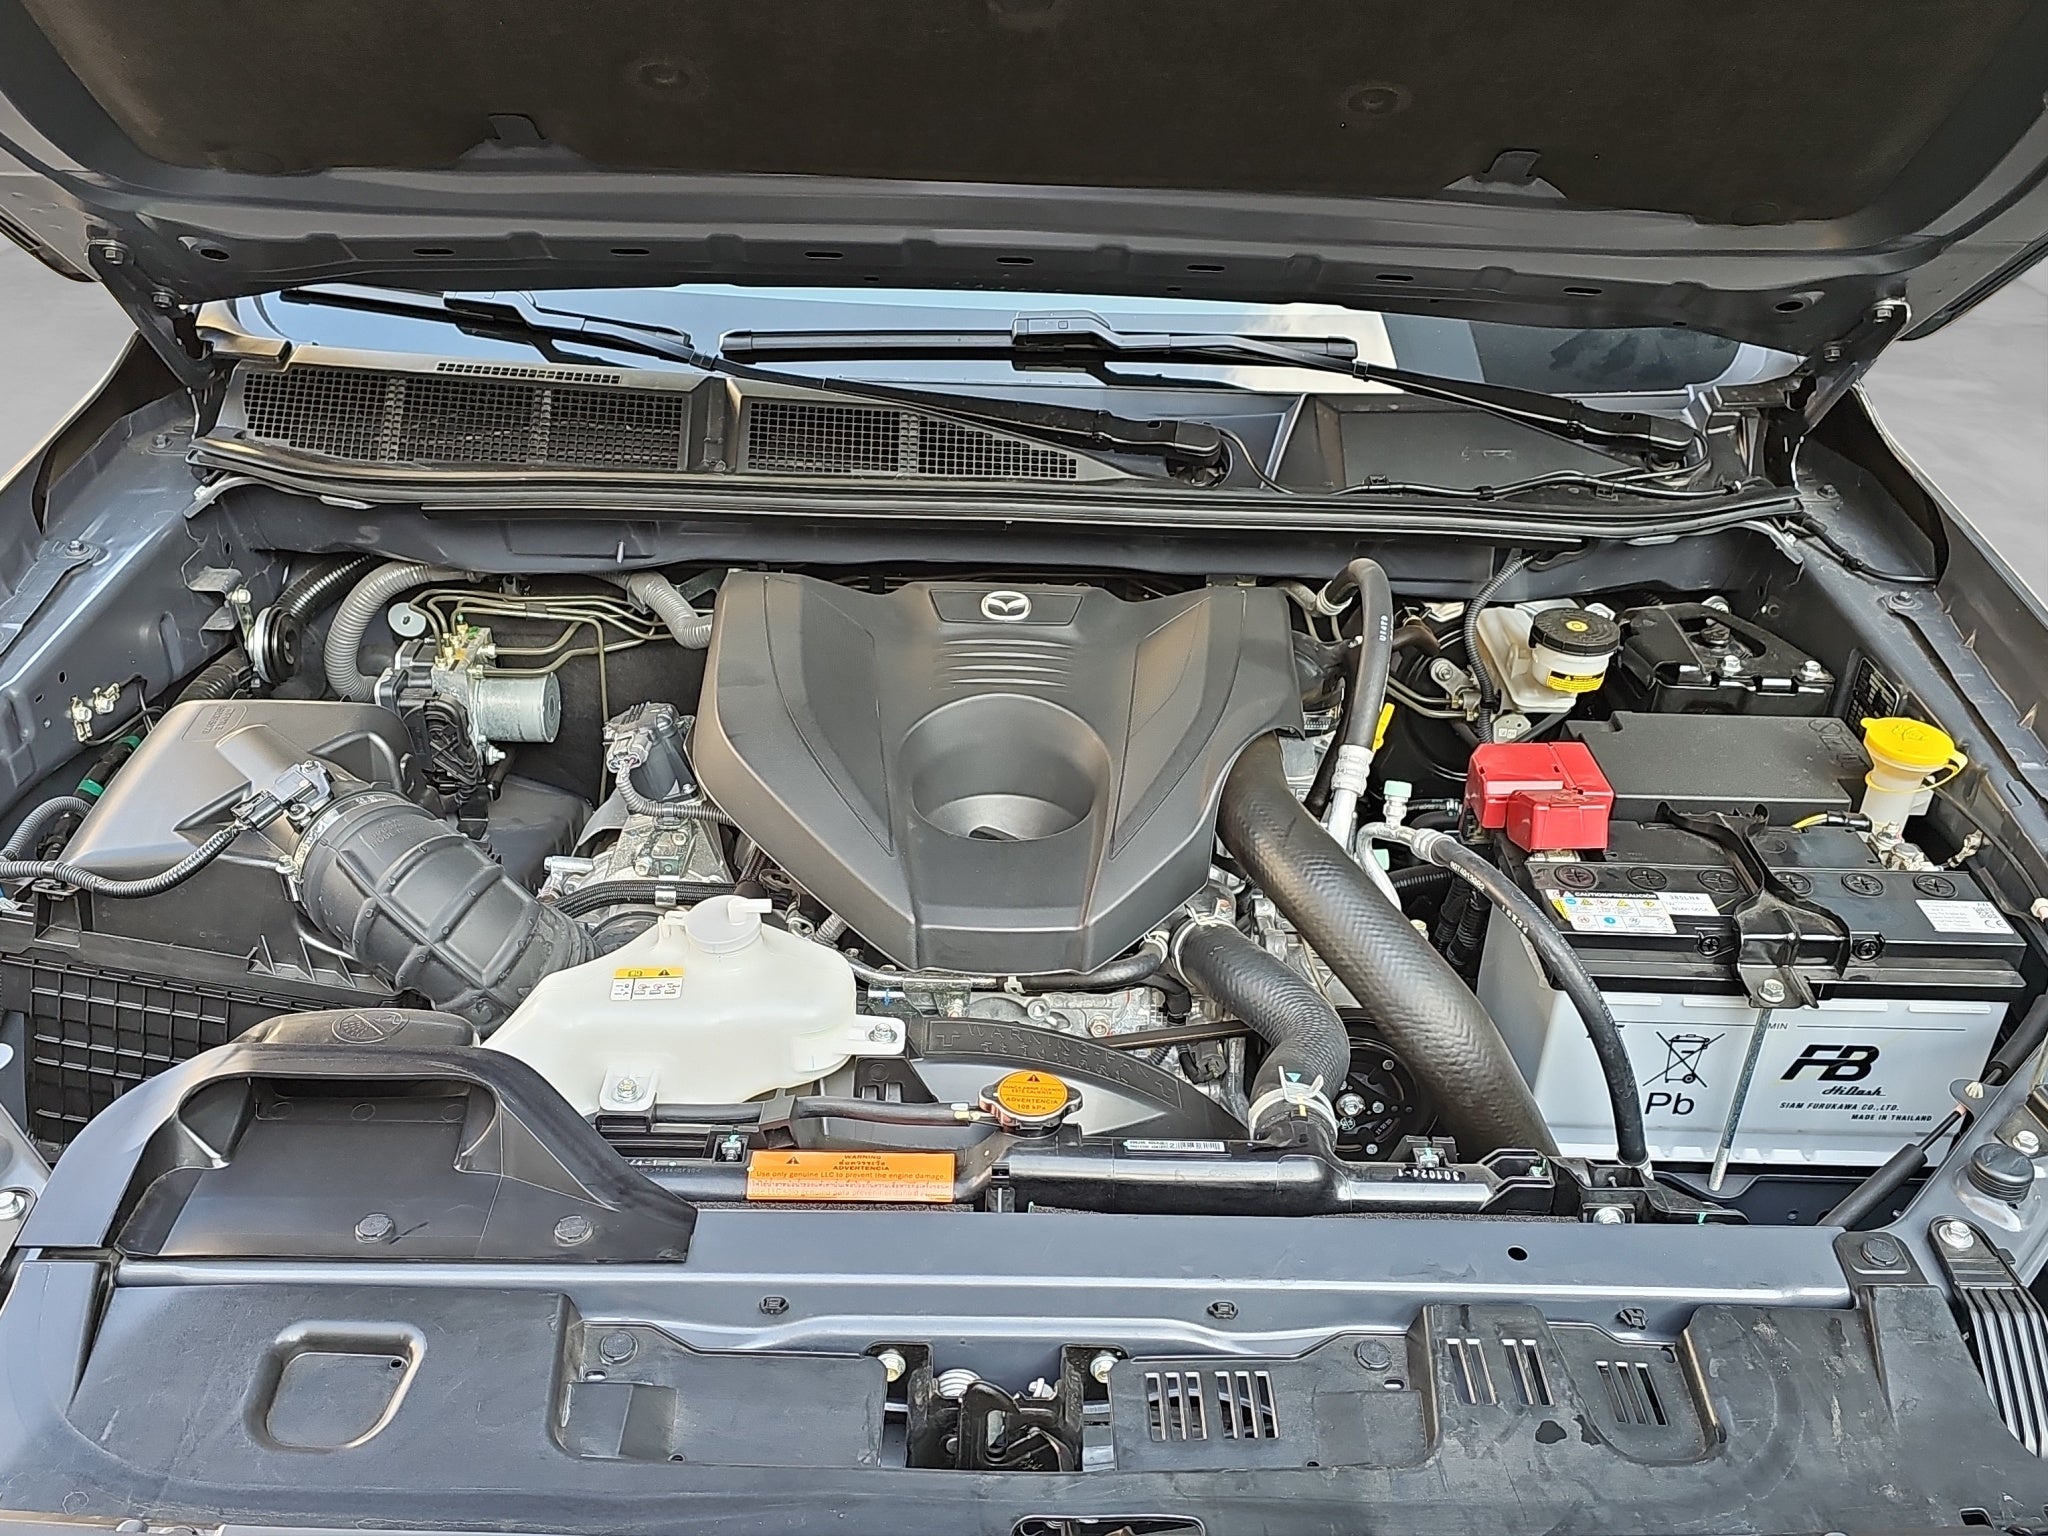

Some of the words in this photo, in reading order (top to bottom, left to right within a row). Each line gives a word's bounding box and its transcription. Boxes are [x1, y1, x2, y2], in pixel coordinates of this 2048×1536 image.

[1767, 1022, 1789, 1030] MIN
[1780, 1044, 1880, 1082] FB
[1005, 1096, 1059, 1105] ADVERTENCIA
[1644, 1092, 1695, 1116] Pb
[772, 1171, 787, 1179] only
